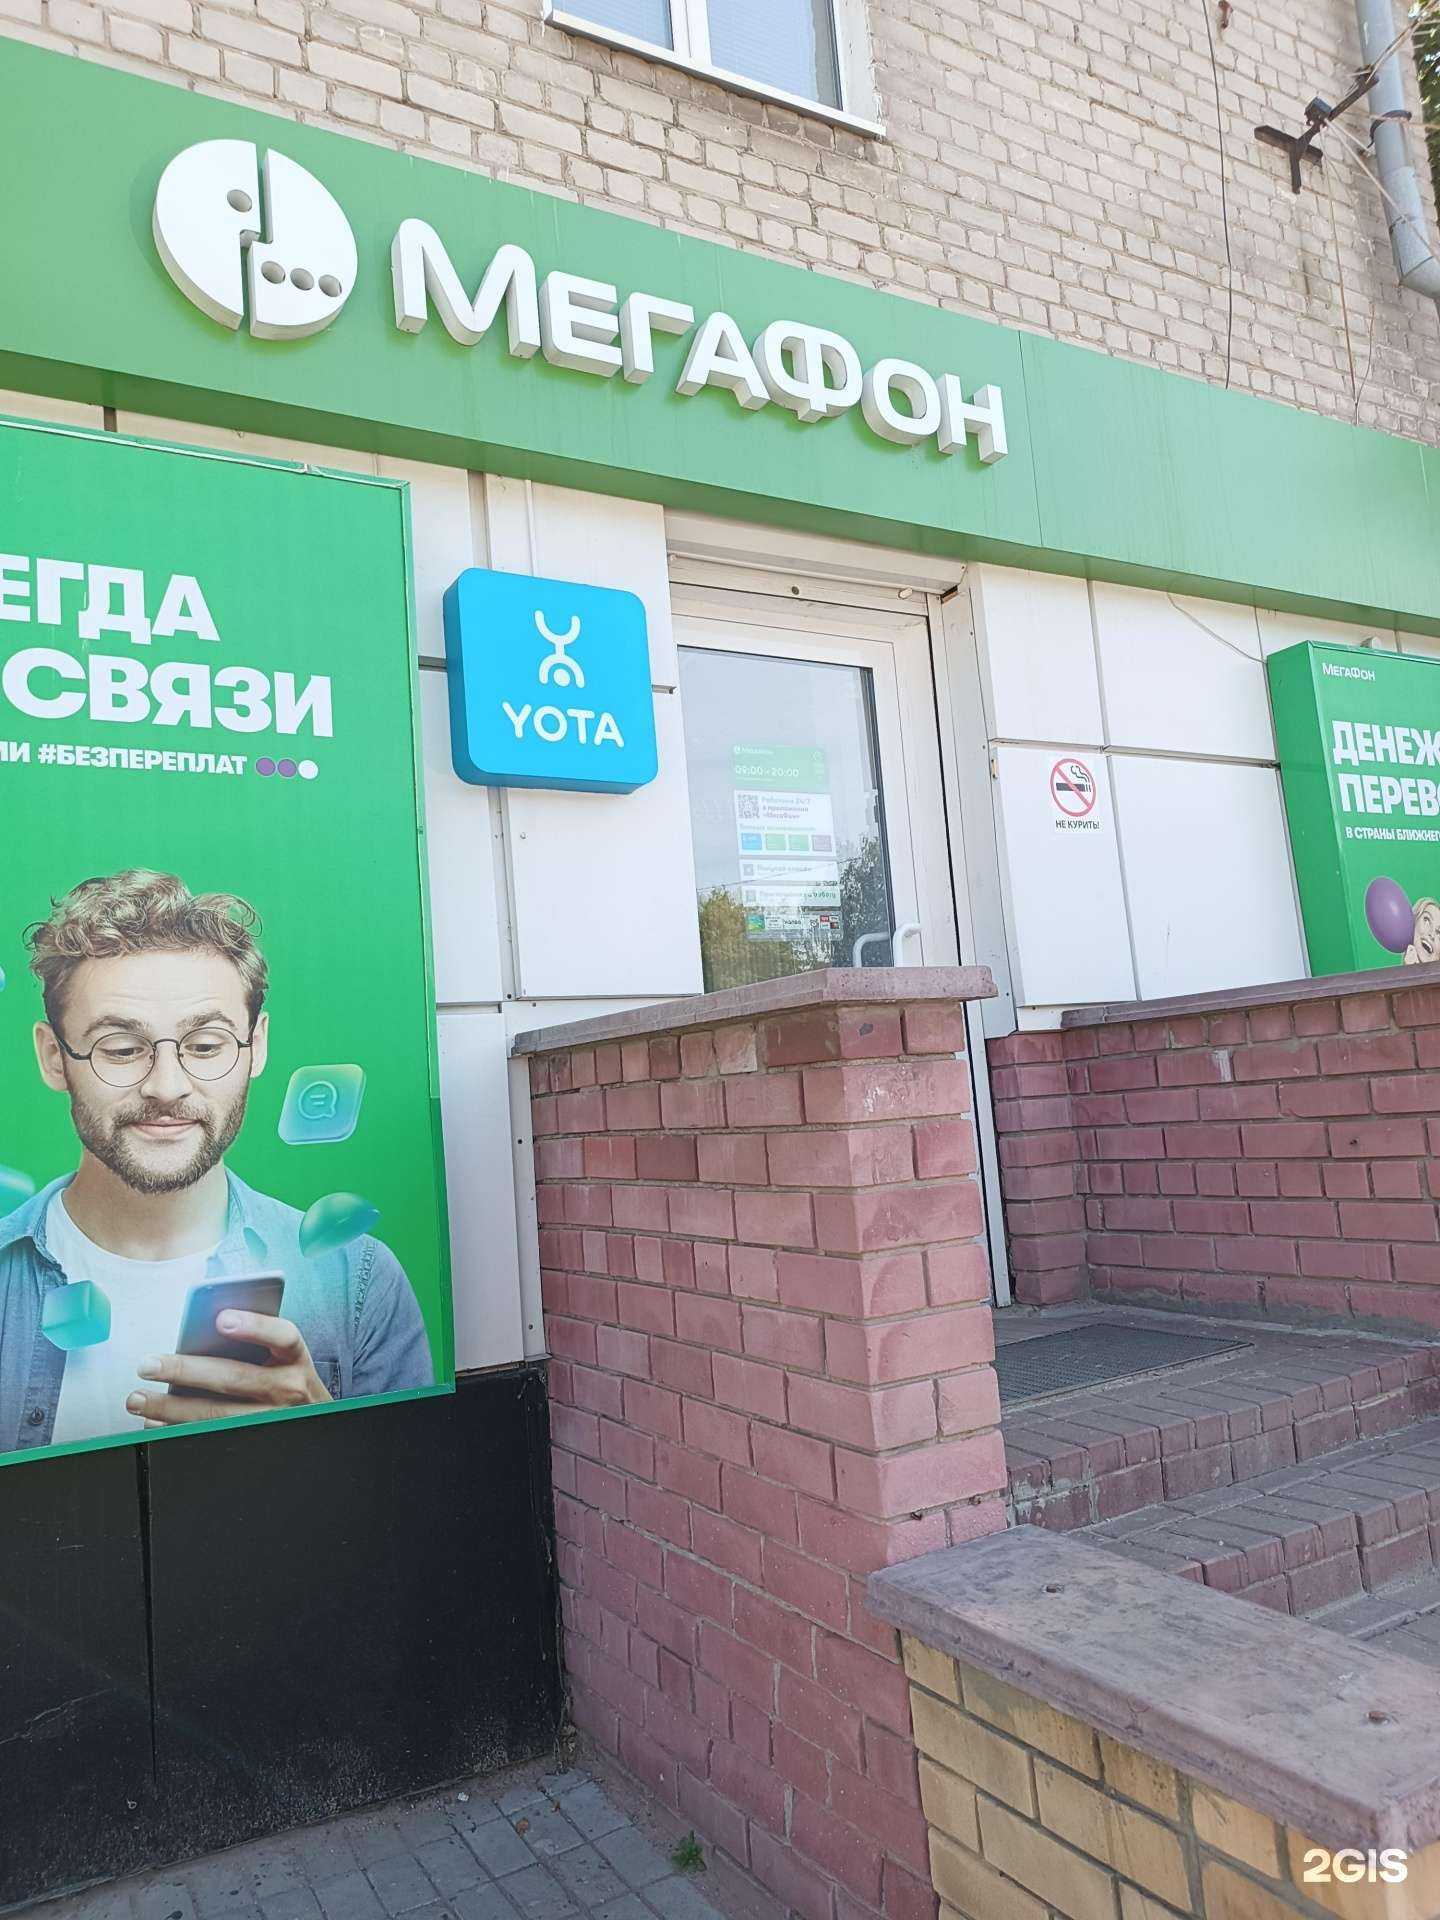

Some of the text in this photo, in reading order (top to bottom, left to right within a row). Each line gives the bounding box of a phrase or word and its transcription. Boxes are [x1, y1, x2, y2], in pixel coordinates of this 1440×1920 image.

[2, 647, 334, 737] СВЯЗИ
[502, 701, 625, 748] YOTA
[37, 743, 247, 775] #БЕЗПЕРЕПЛАТ
[1338, 773, 1440, 817] ПЕРЕВ
[1055, 820, 1100, 830] НЕ КУРИТЬ!
[1345, 826, 1440, 842] В СТРАНЫ БЛИЖНЕГ
